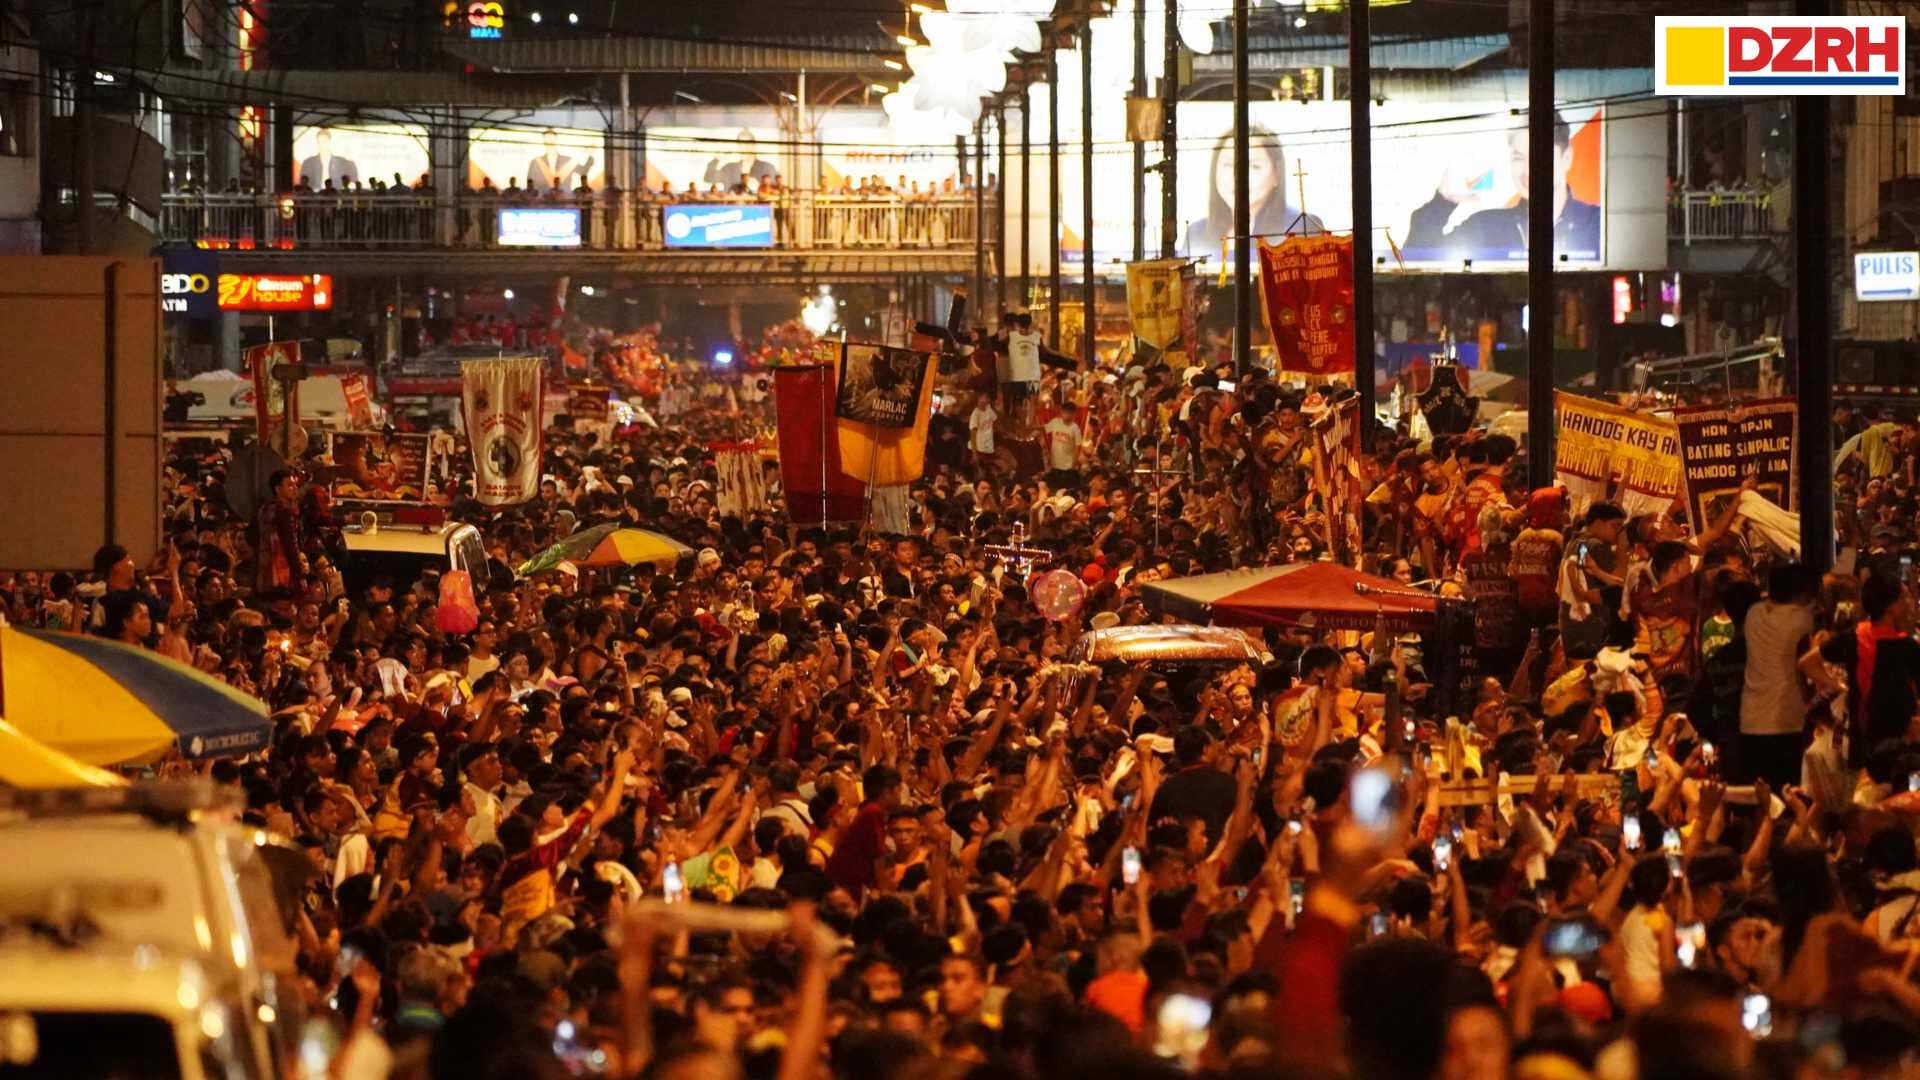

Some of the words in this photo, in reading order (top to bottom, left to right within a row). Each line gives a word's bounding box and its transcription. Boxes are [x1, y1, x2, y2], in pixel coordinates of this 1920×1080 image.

[1861, 256, 1913, 275] PULIS
[162, 274, 209, 293] BDO
[1562, 410, 1624, 441] HANDOG
[1627, 427, 1659, 450] KAY
[1687, 443, 1732, 460] BATANG
[1688, 464, 1737, 479] HANDOG
